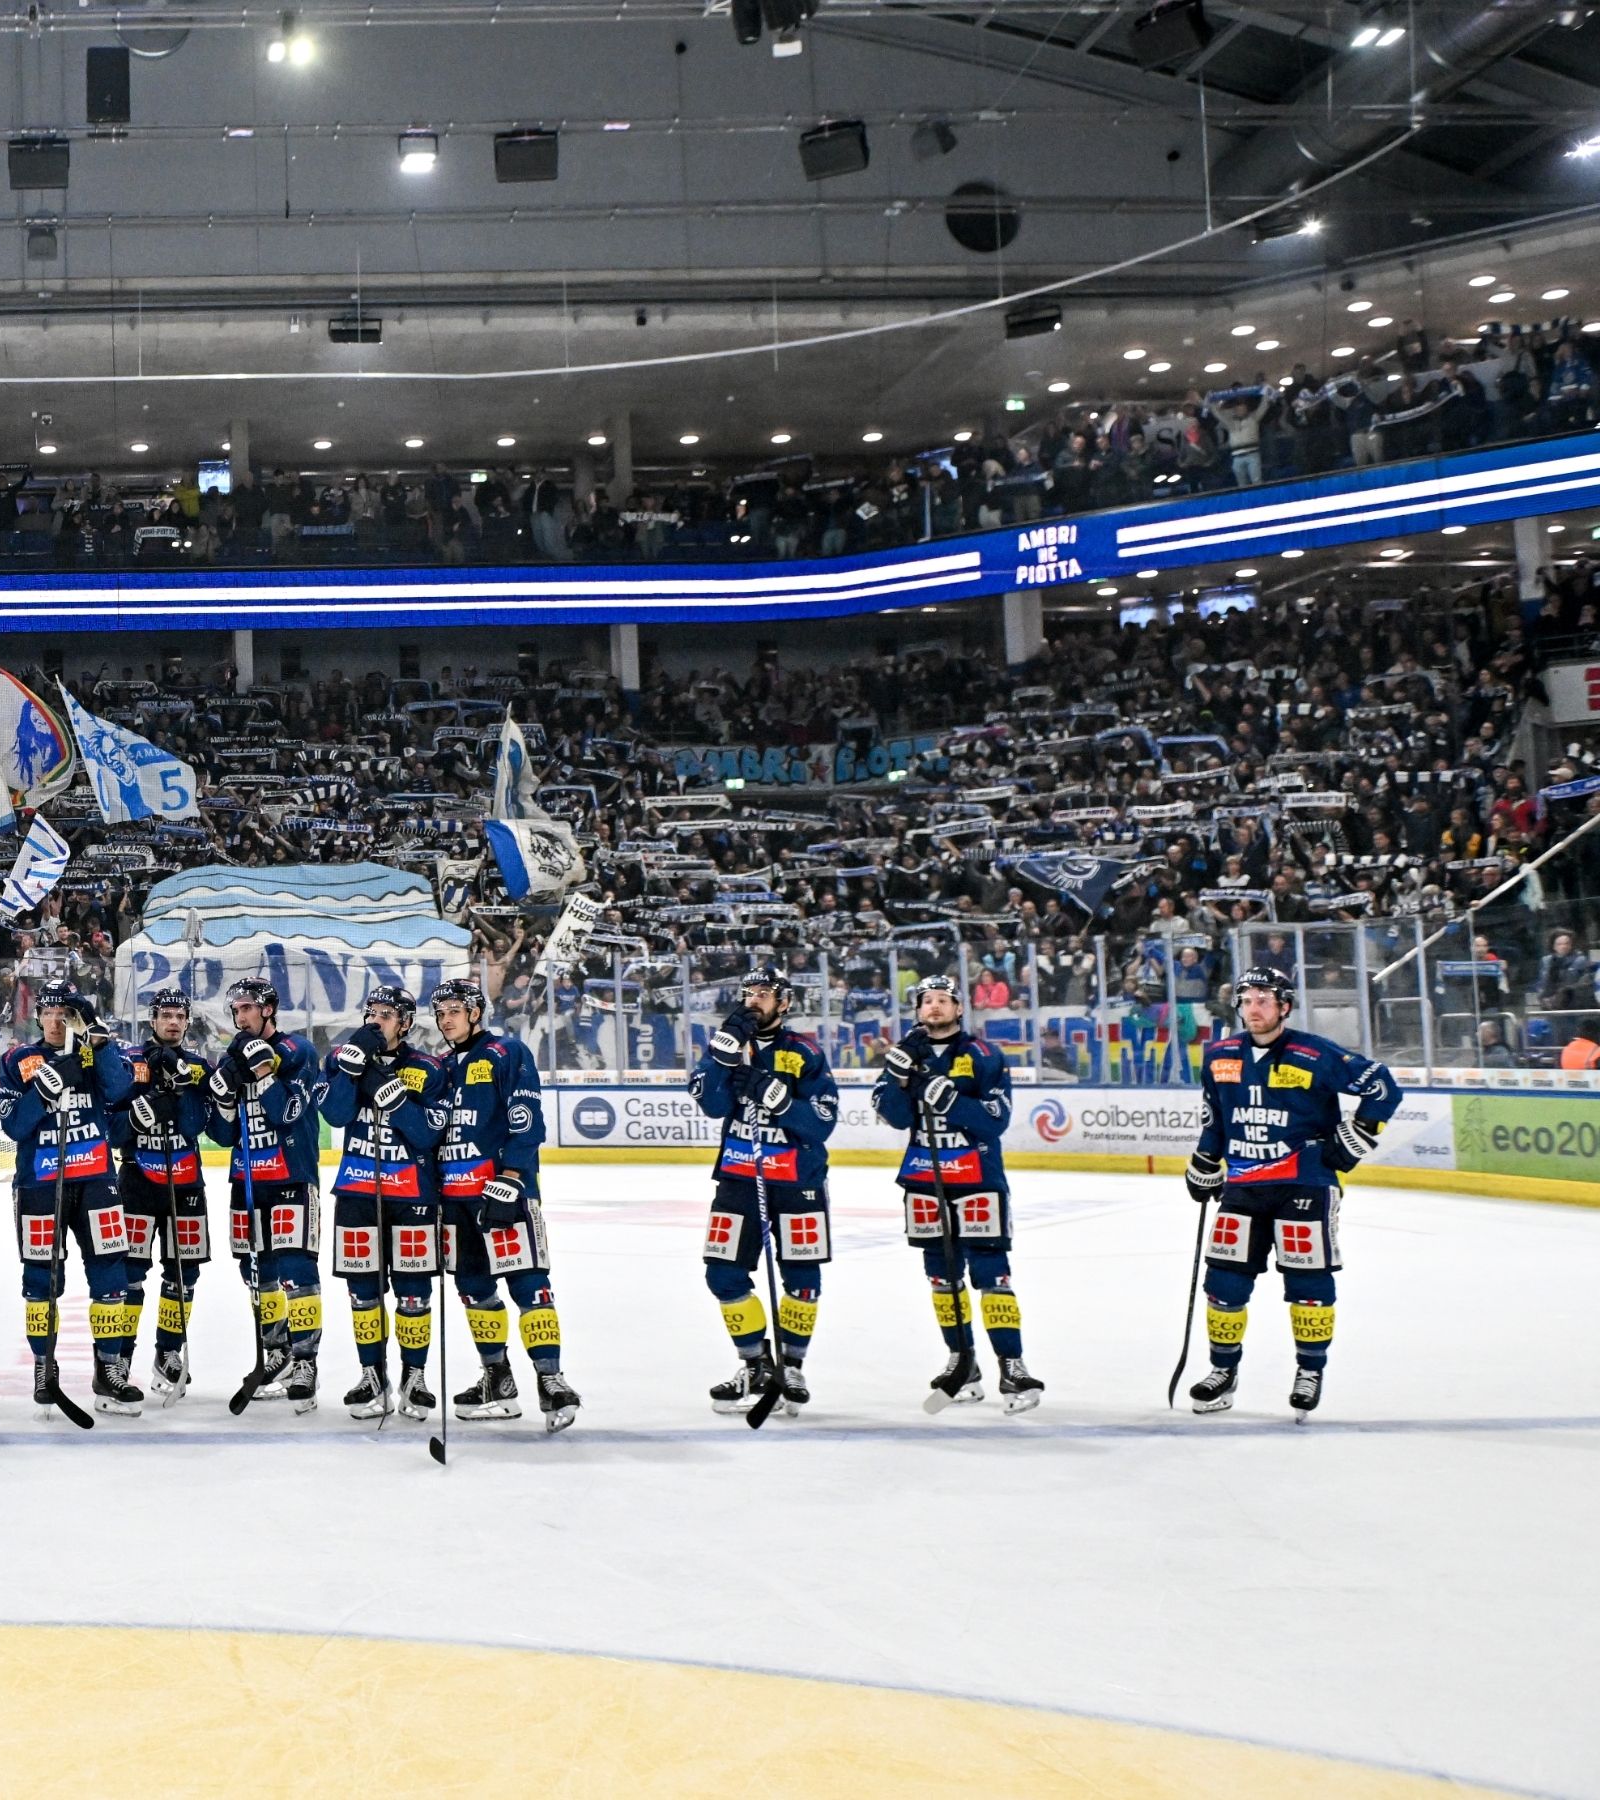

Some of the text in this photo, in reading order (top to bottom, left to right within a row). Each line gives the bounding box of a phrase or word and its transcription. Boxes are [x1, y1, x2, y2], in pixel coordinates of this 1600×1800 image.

[1018, 525, 1077, 554] AMBRI
[1037, 546, 1058, 564] HC
[1015, 560, 1083, 586] PIOTTA
[160, 767, 190, 811] 5
[132, 951, 223, 1006] 20
[1248, 1085, 1262, 1106] 11
[1231, 1107, 1289, 1127] AMBRI
[626, 1121, 709, 1141] Cavalli
[1244, 1125, 1268, 1141] HC
[1228, 1139, 1292, 1160] PIOTTA
[344, 1260, 362, 1269] Studio
[400, 1260, 420, 1269] Studio
[1283, 1254, 1304, 1264] Studio
